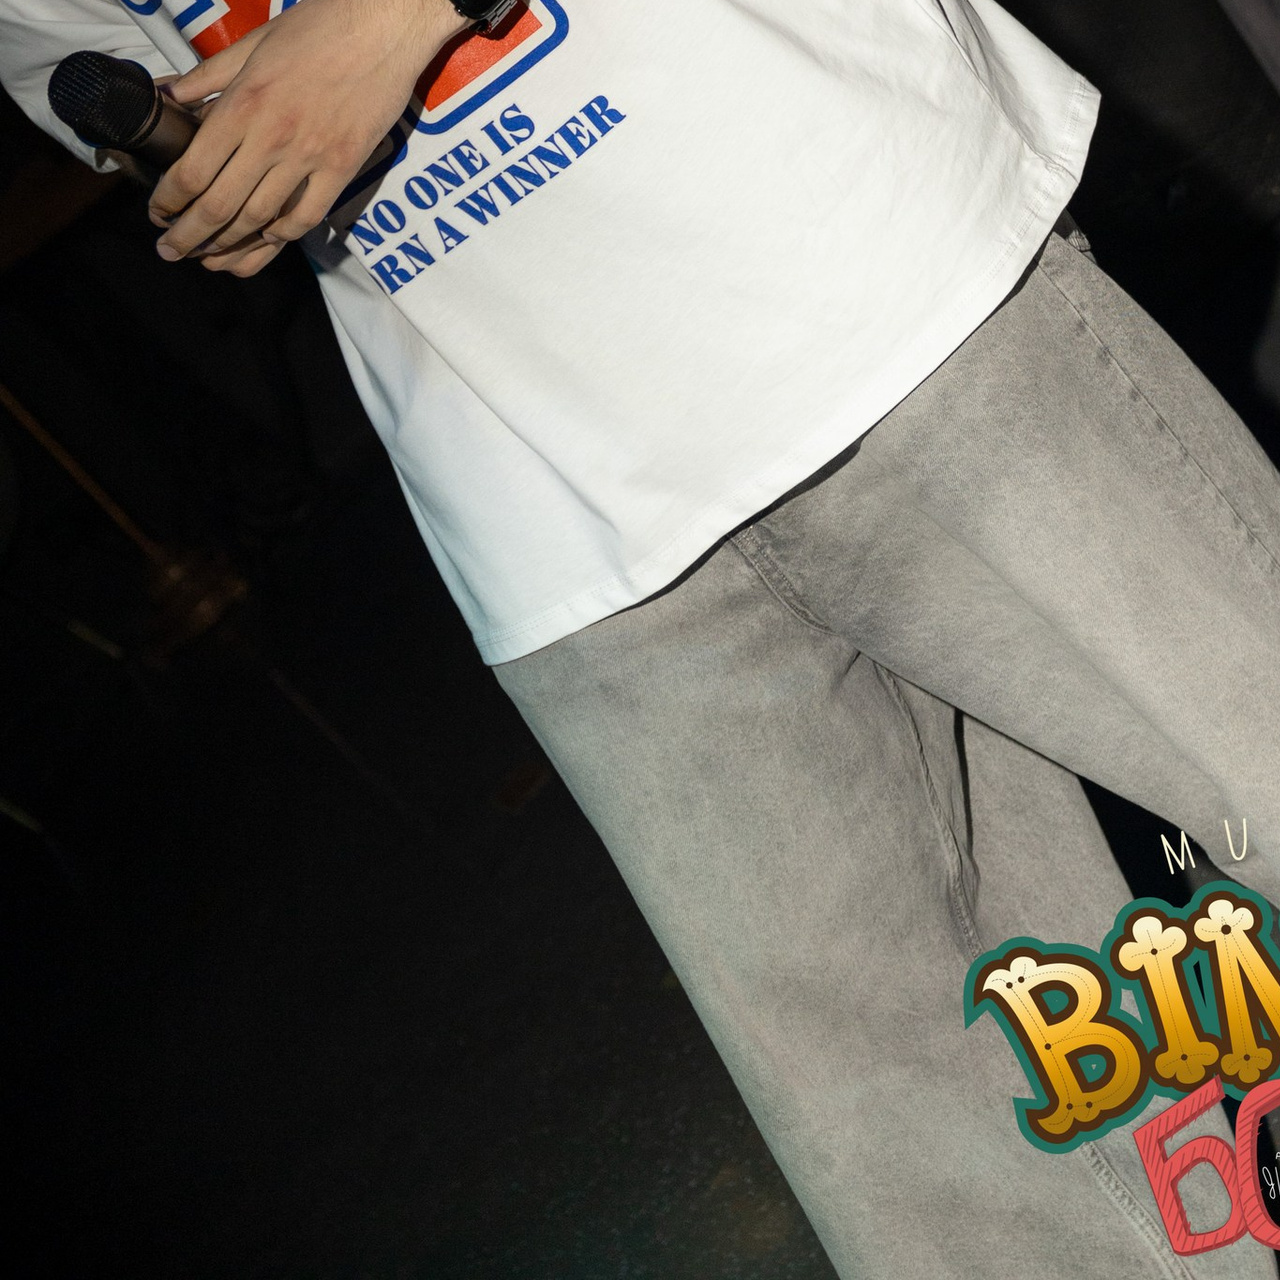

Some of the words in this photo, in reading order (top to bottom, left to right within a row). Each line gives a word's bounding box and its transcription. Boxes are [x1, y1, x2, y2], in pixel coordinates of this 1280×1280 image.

[346, 199, 407, 256] NO
[404, 139, 490, 211] ONE
[480, 103, 535, 156] IS
[433, 216, 469, 254] A
[454, 95, 627, 226] WINNER
